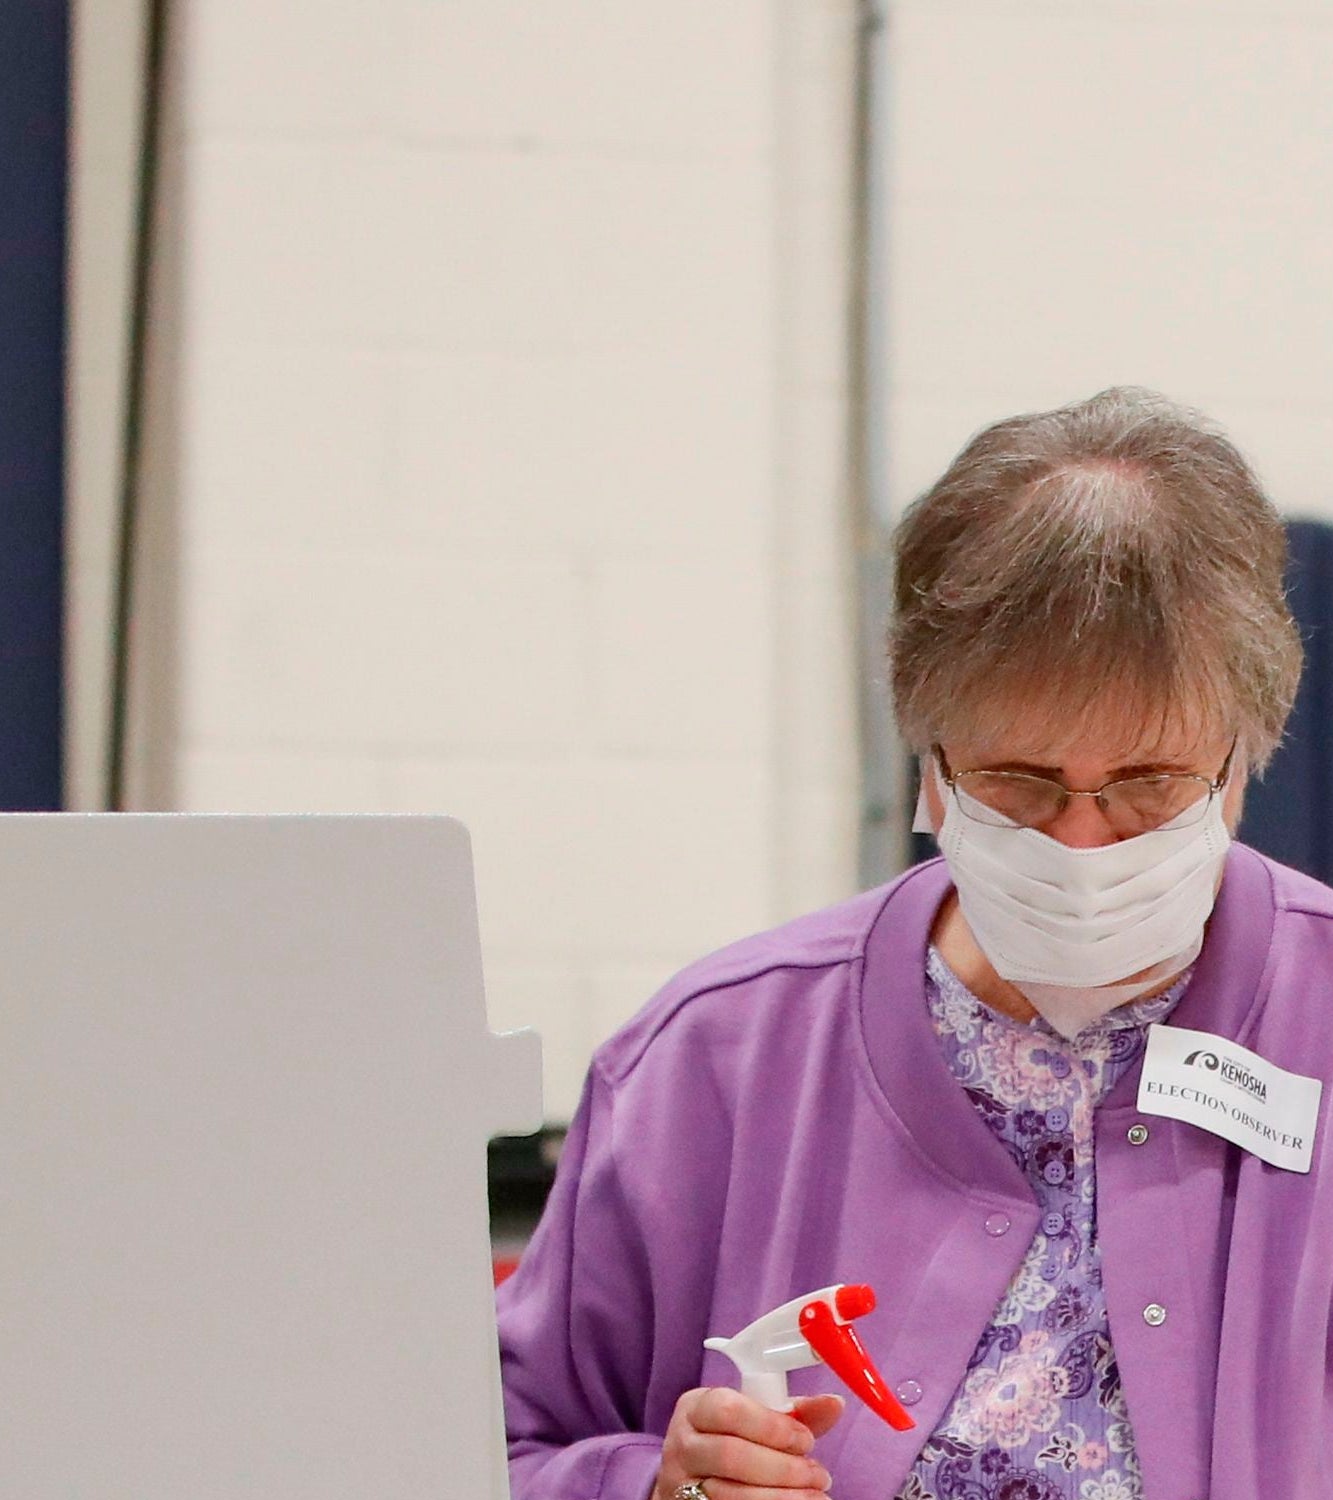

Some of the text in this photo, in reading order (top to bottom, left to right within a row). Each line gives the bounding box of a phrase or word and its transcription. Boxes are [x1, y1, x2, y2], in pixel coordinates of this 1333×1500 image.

[1220, 1061, 1267, 1100] KENOSHA
[1147, 1081, 1229, 1114] ELECTION
[1231, 1107, 1304, 1150] OBSERVER
